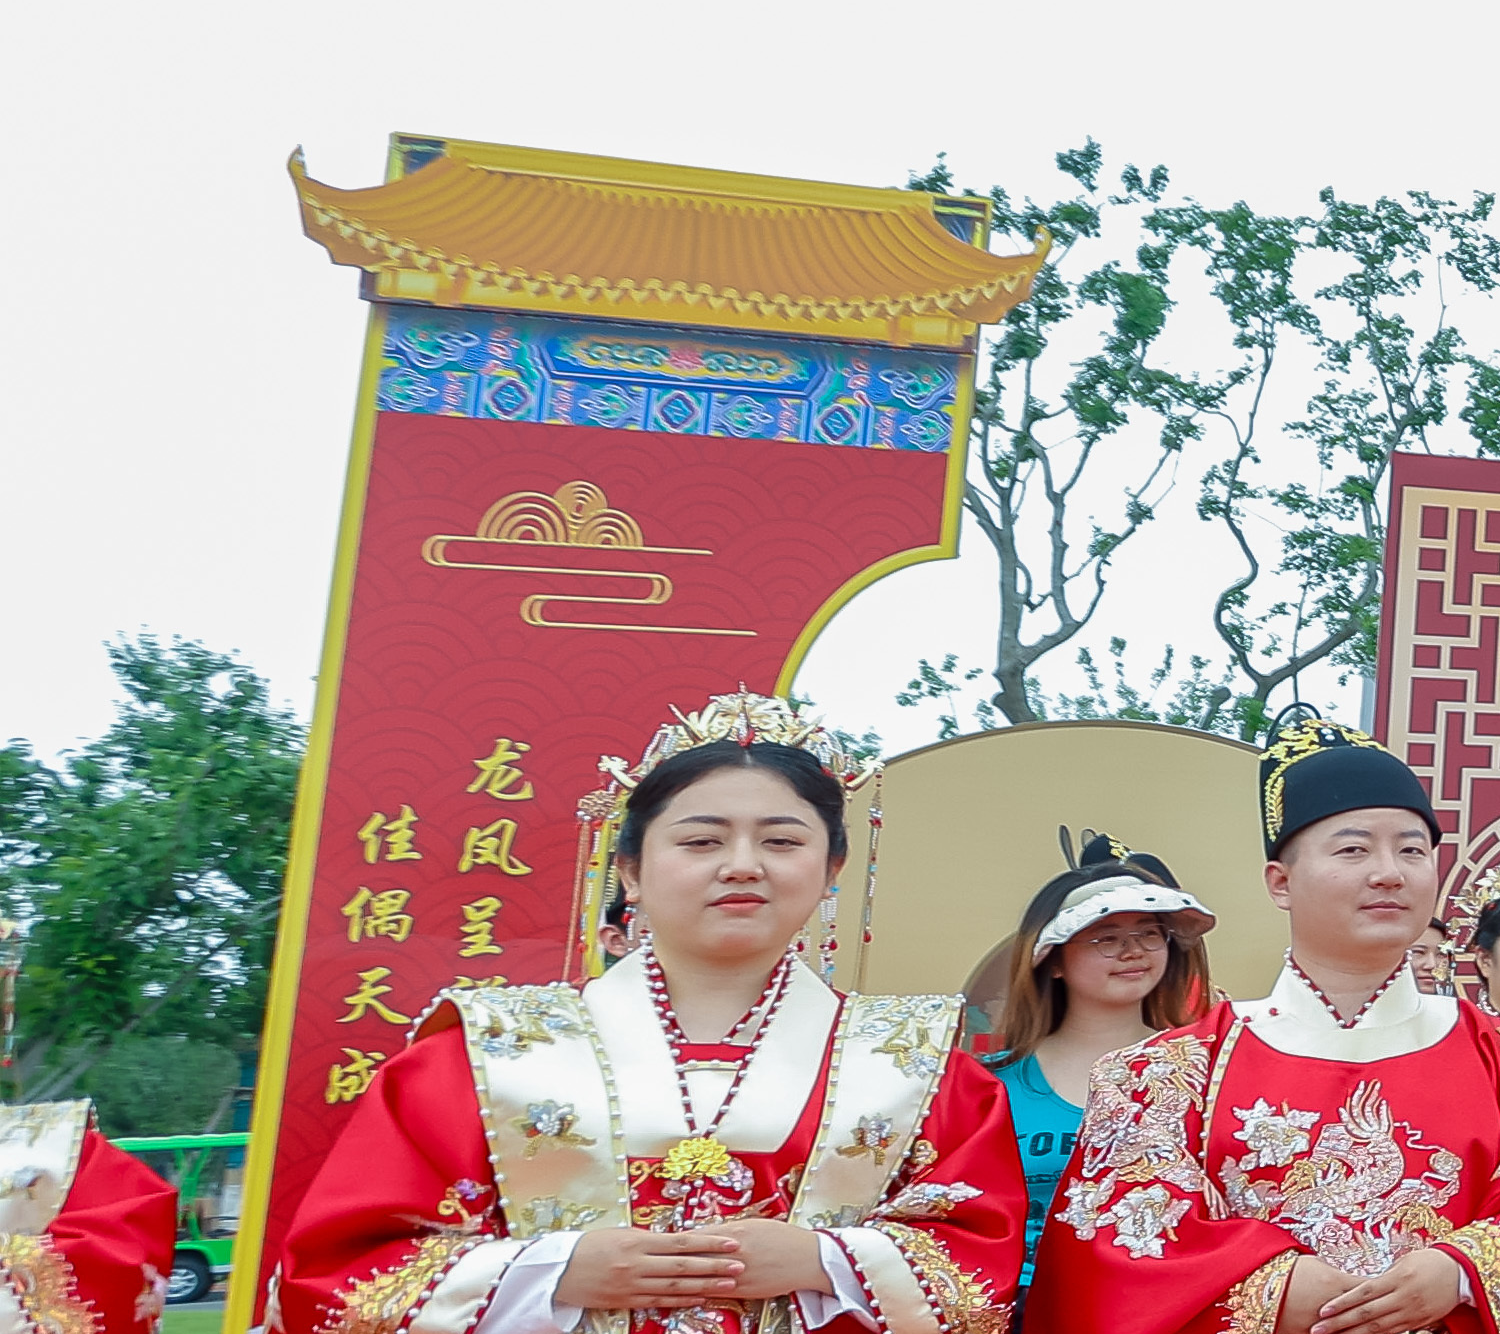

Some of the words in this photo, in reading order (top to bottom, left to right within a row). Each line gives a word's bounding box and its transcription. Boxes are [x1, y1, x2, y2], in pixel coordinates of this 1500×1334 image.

[325, 804, 423, 1105] 佳偶天成
[450, 738, 535, 989] 龙凤呈
